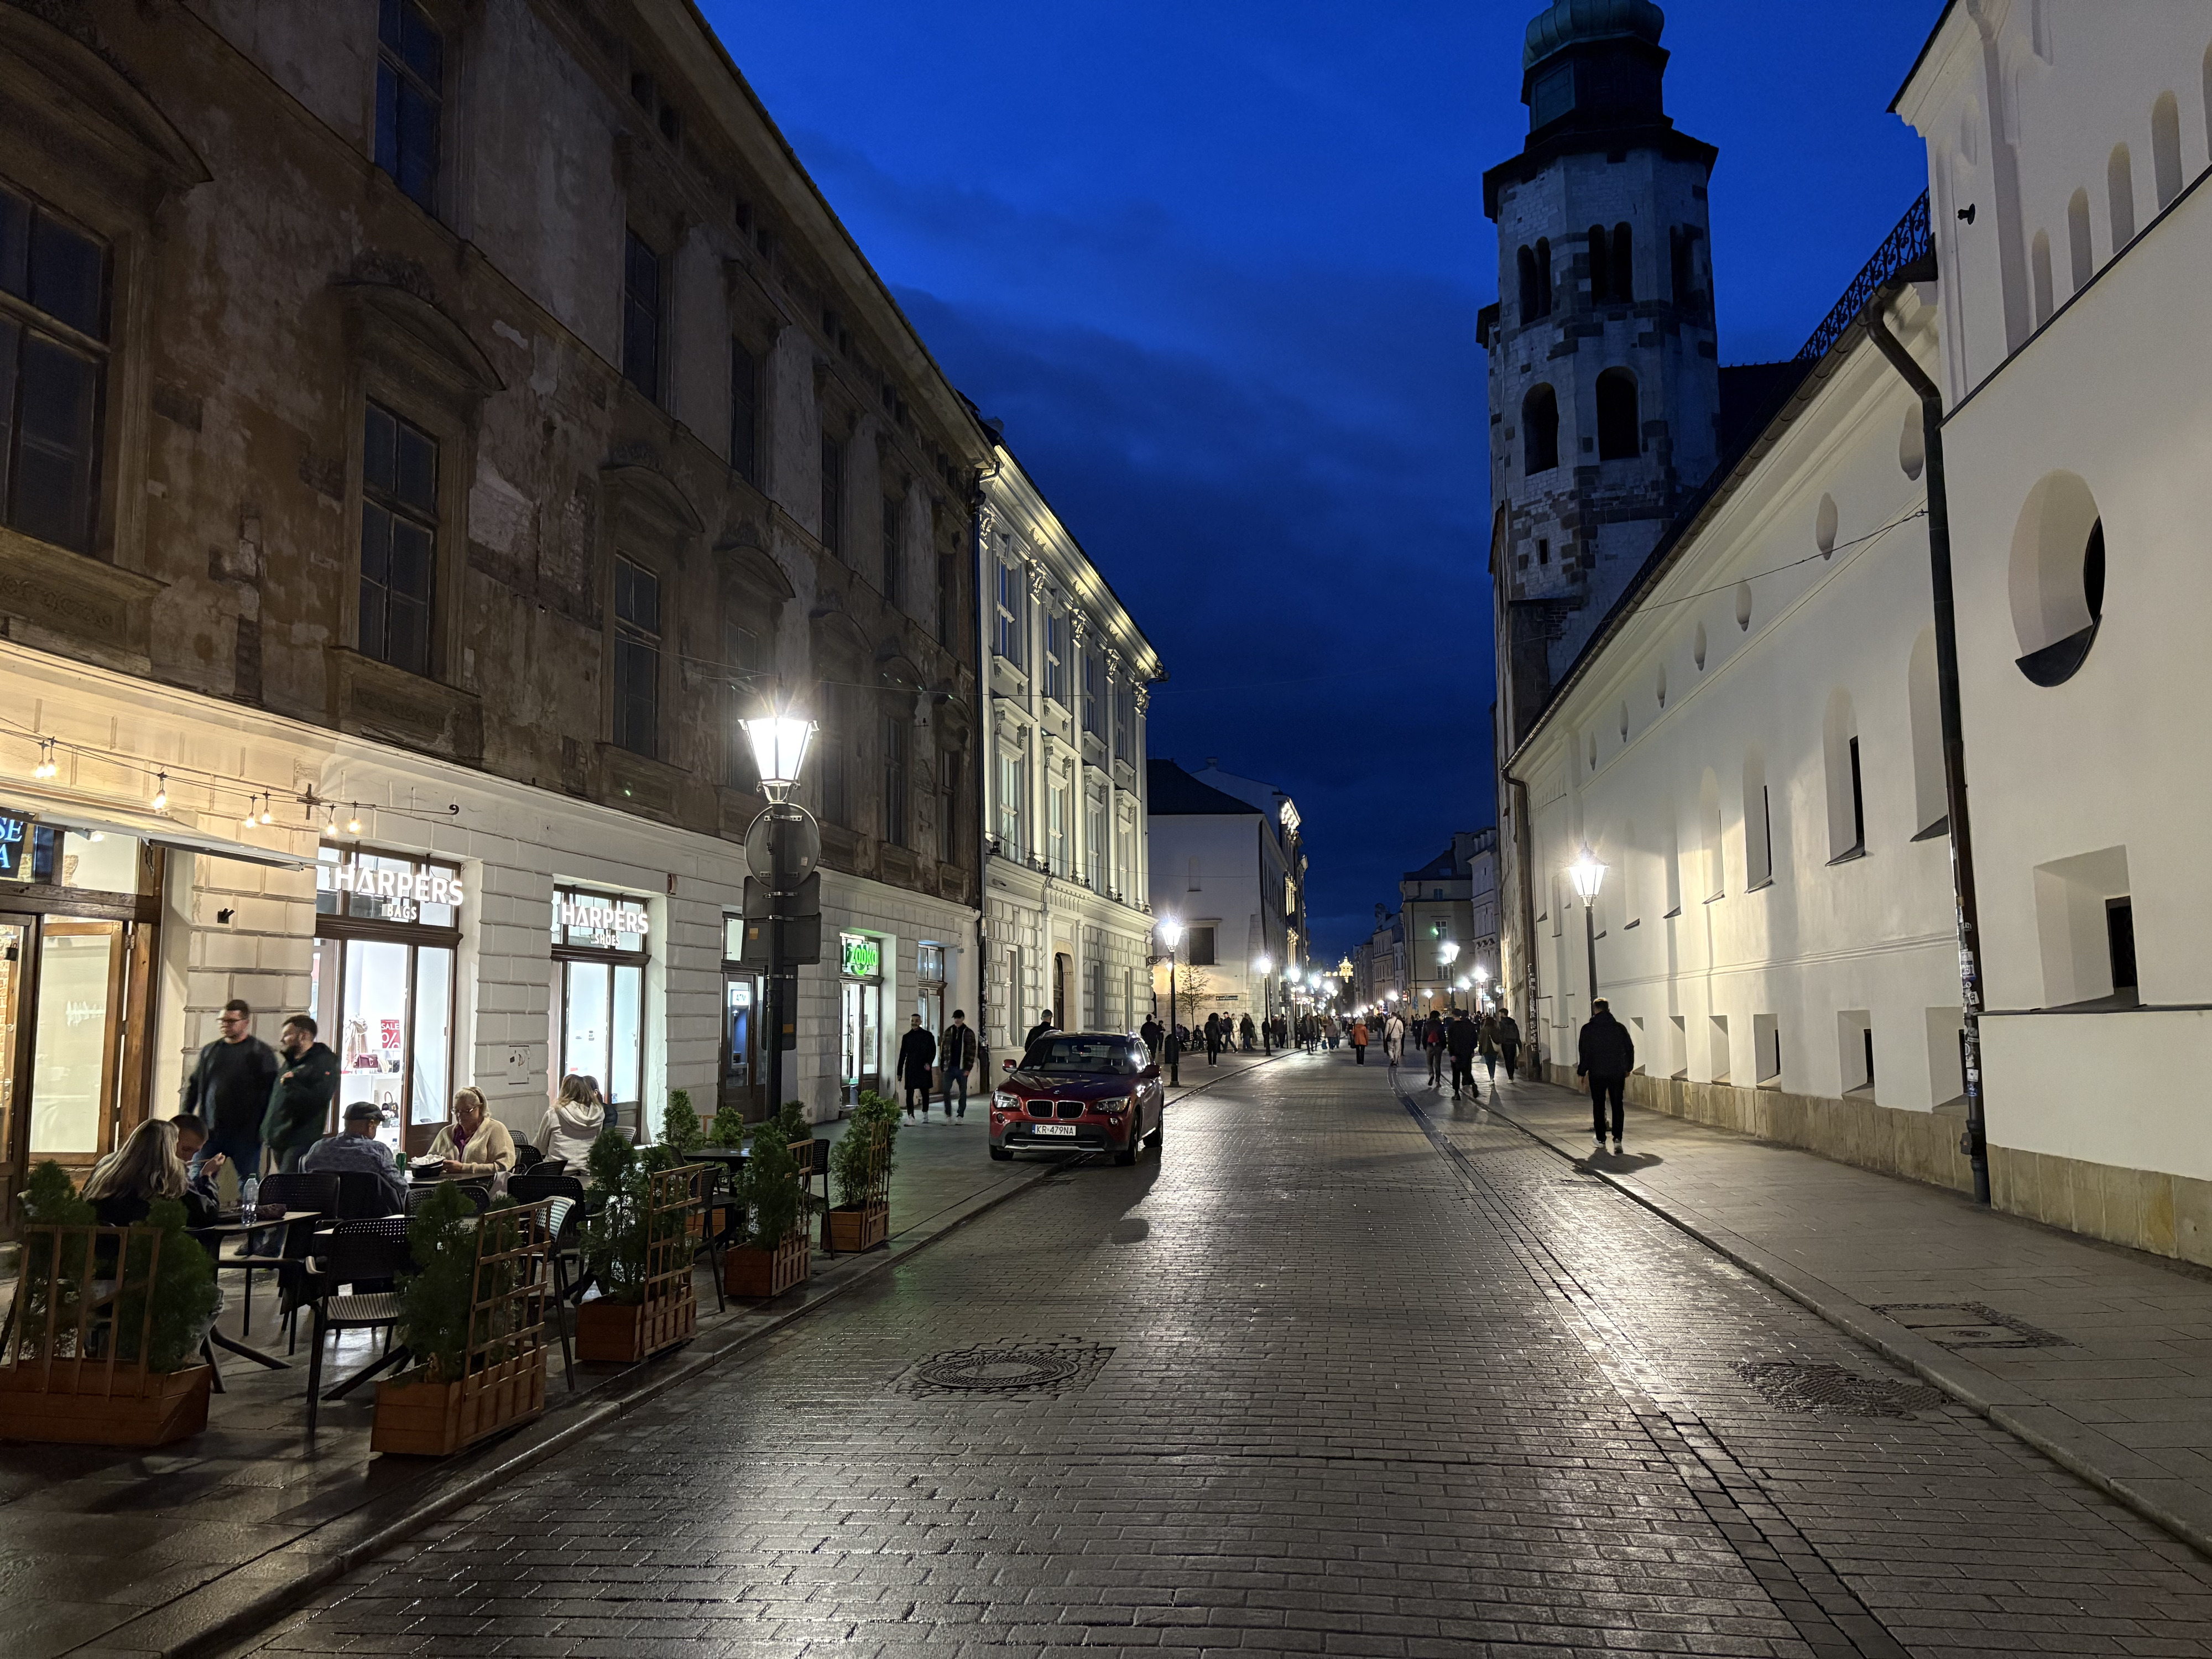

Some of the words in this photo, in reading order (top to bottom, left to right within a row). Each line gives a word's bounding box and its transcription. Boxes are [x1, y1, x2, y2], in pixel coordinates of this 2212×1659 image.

[334, 865, 463, 906] HARPERS
[387, 903, 417, 920] BAGS
[562, 902, 649, 934] HARPERS
[594, 933, 620, 946] SHOES
[1036, 1125, 1047, 1134] KR
[1050, 1126, 1073, 1135] 479NA
